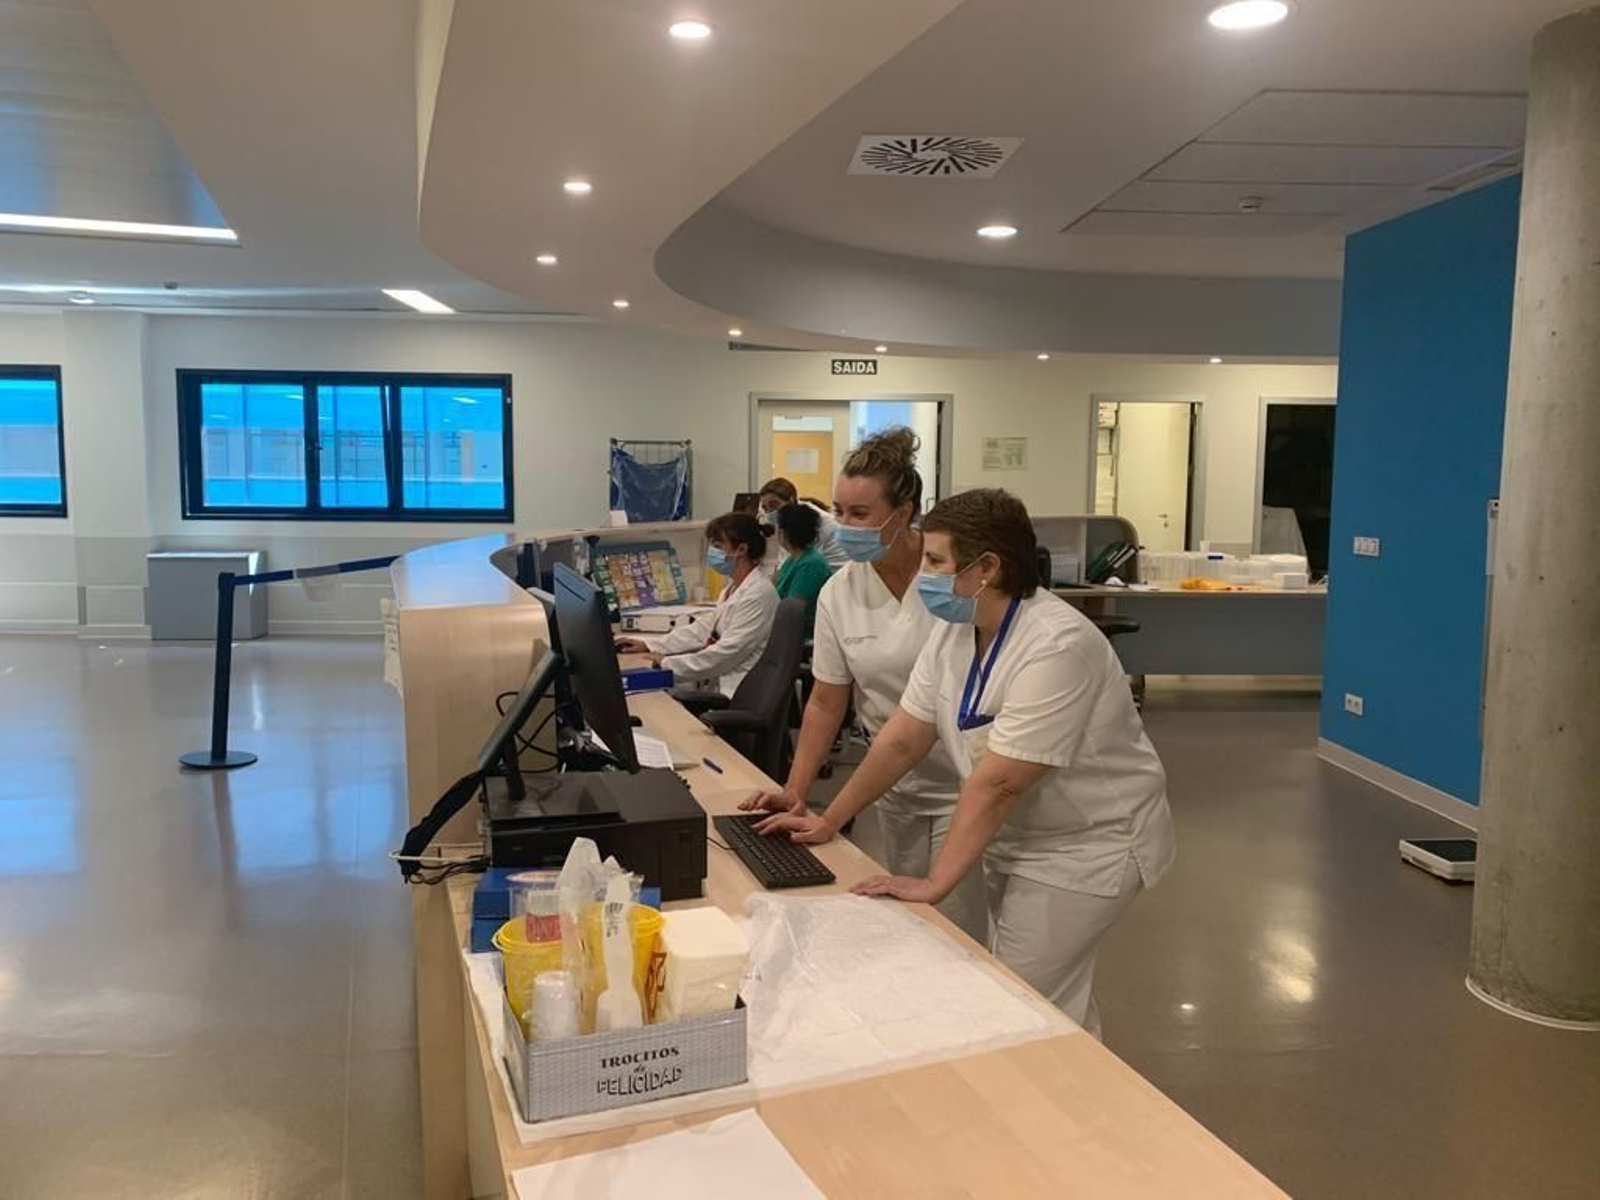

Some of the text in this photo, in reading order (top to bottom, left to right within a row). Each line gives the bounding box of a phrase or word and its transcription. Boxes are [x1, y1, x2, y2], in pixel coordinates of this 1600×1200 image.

[833, 361, 876, 374] SAIDA
[601, 1047, 679, 1069] TROCITOS
[597, 1066, 682, 1095] FELICIDAD
